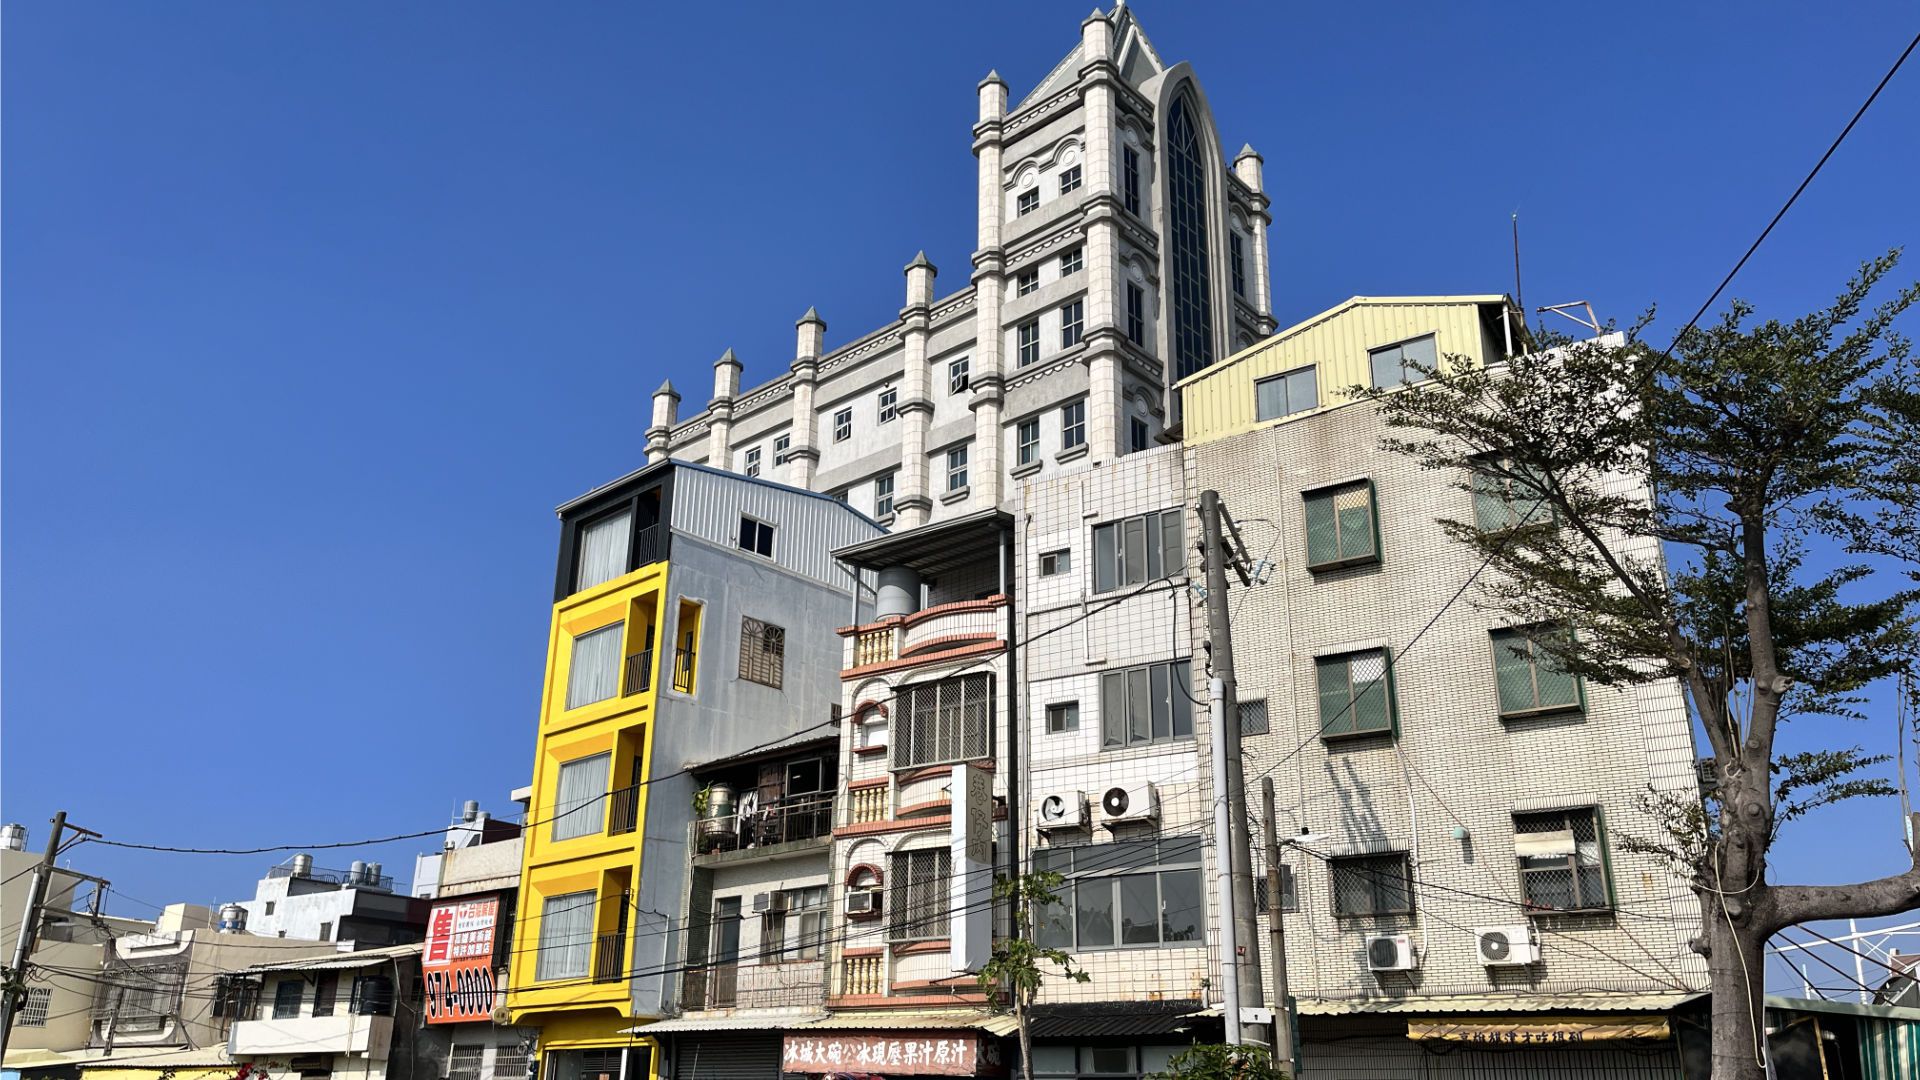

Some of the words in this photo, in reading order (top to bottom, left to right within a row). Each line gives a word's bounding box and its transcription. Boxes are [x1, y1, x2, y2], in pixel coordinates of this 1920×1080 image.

[429, 909, 453, 961] 售
[453, 942, 490, 957] 特許加盟店
[427, 966, 493, 1018] 974-0000
